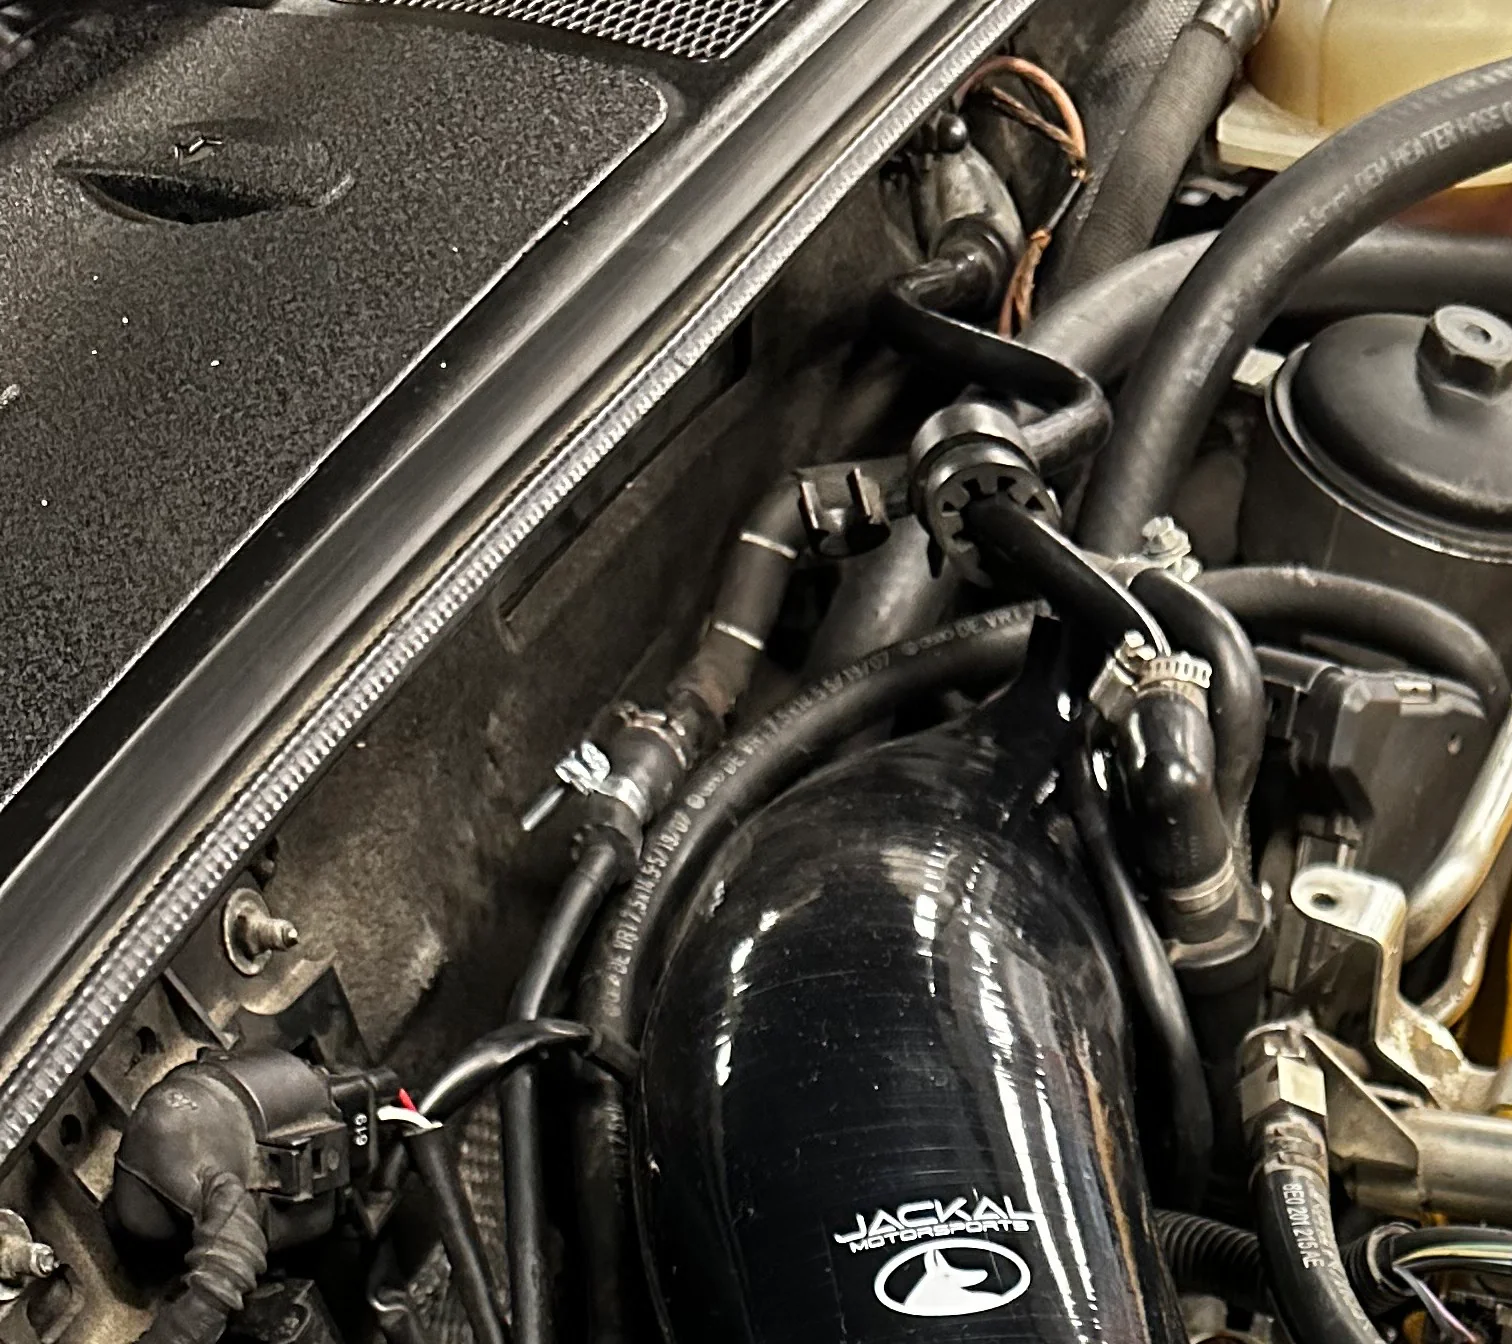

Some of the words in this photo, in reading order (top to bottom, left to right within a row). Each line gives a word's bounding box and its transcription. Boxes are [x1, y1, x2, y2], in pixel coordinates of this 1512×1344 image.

[1393, 120, 1458, 168] HEATER
[833, 1195, 1037, 1244] JACKAL
[849, 1217, 1030, 1254] MOTORSPORTS
[1286, 1206, 1312, 1227] 201
